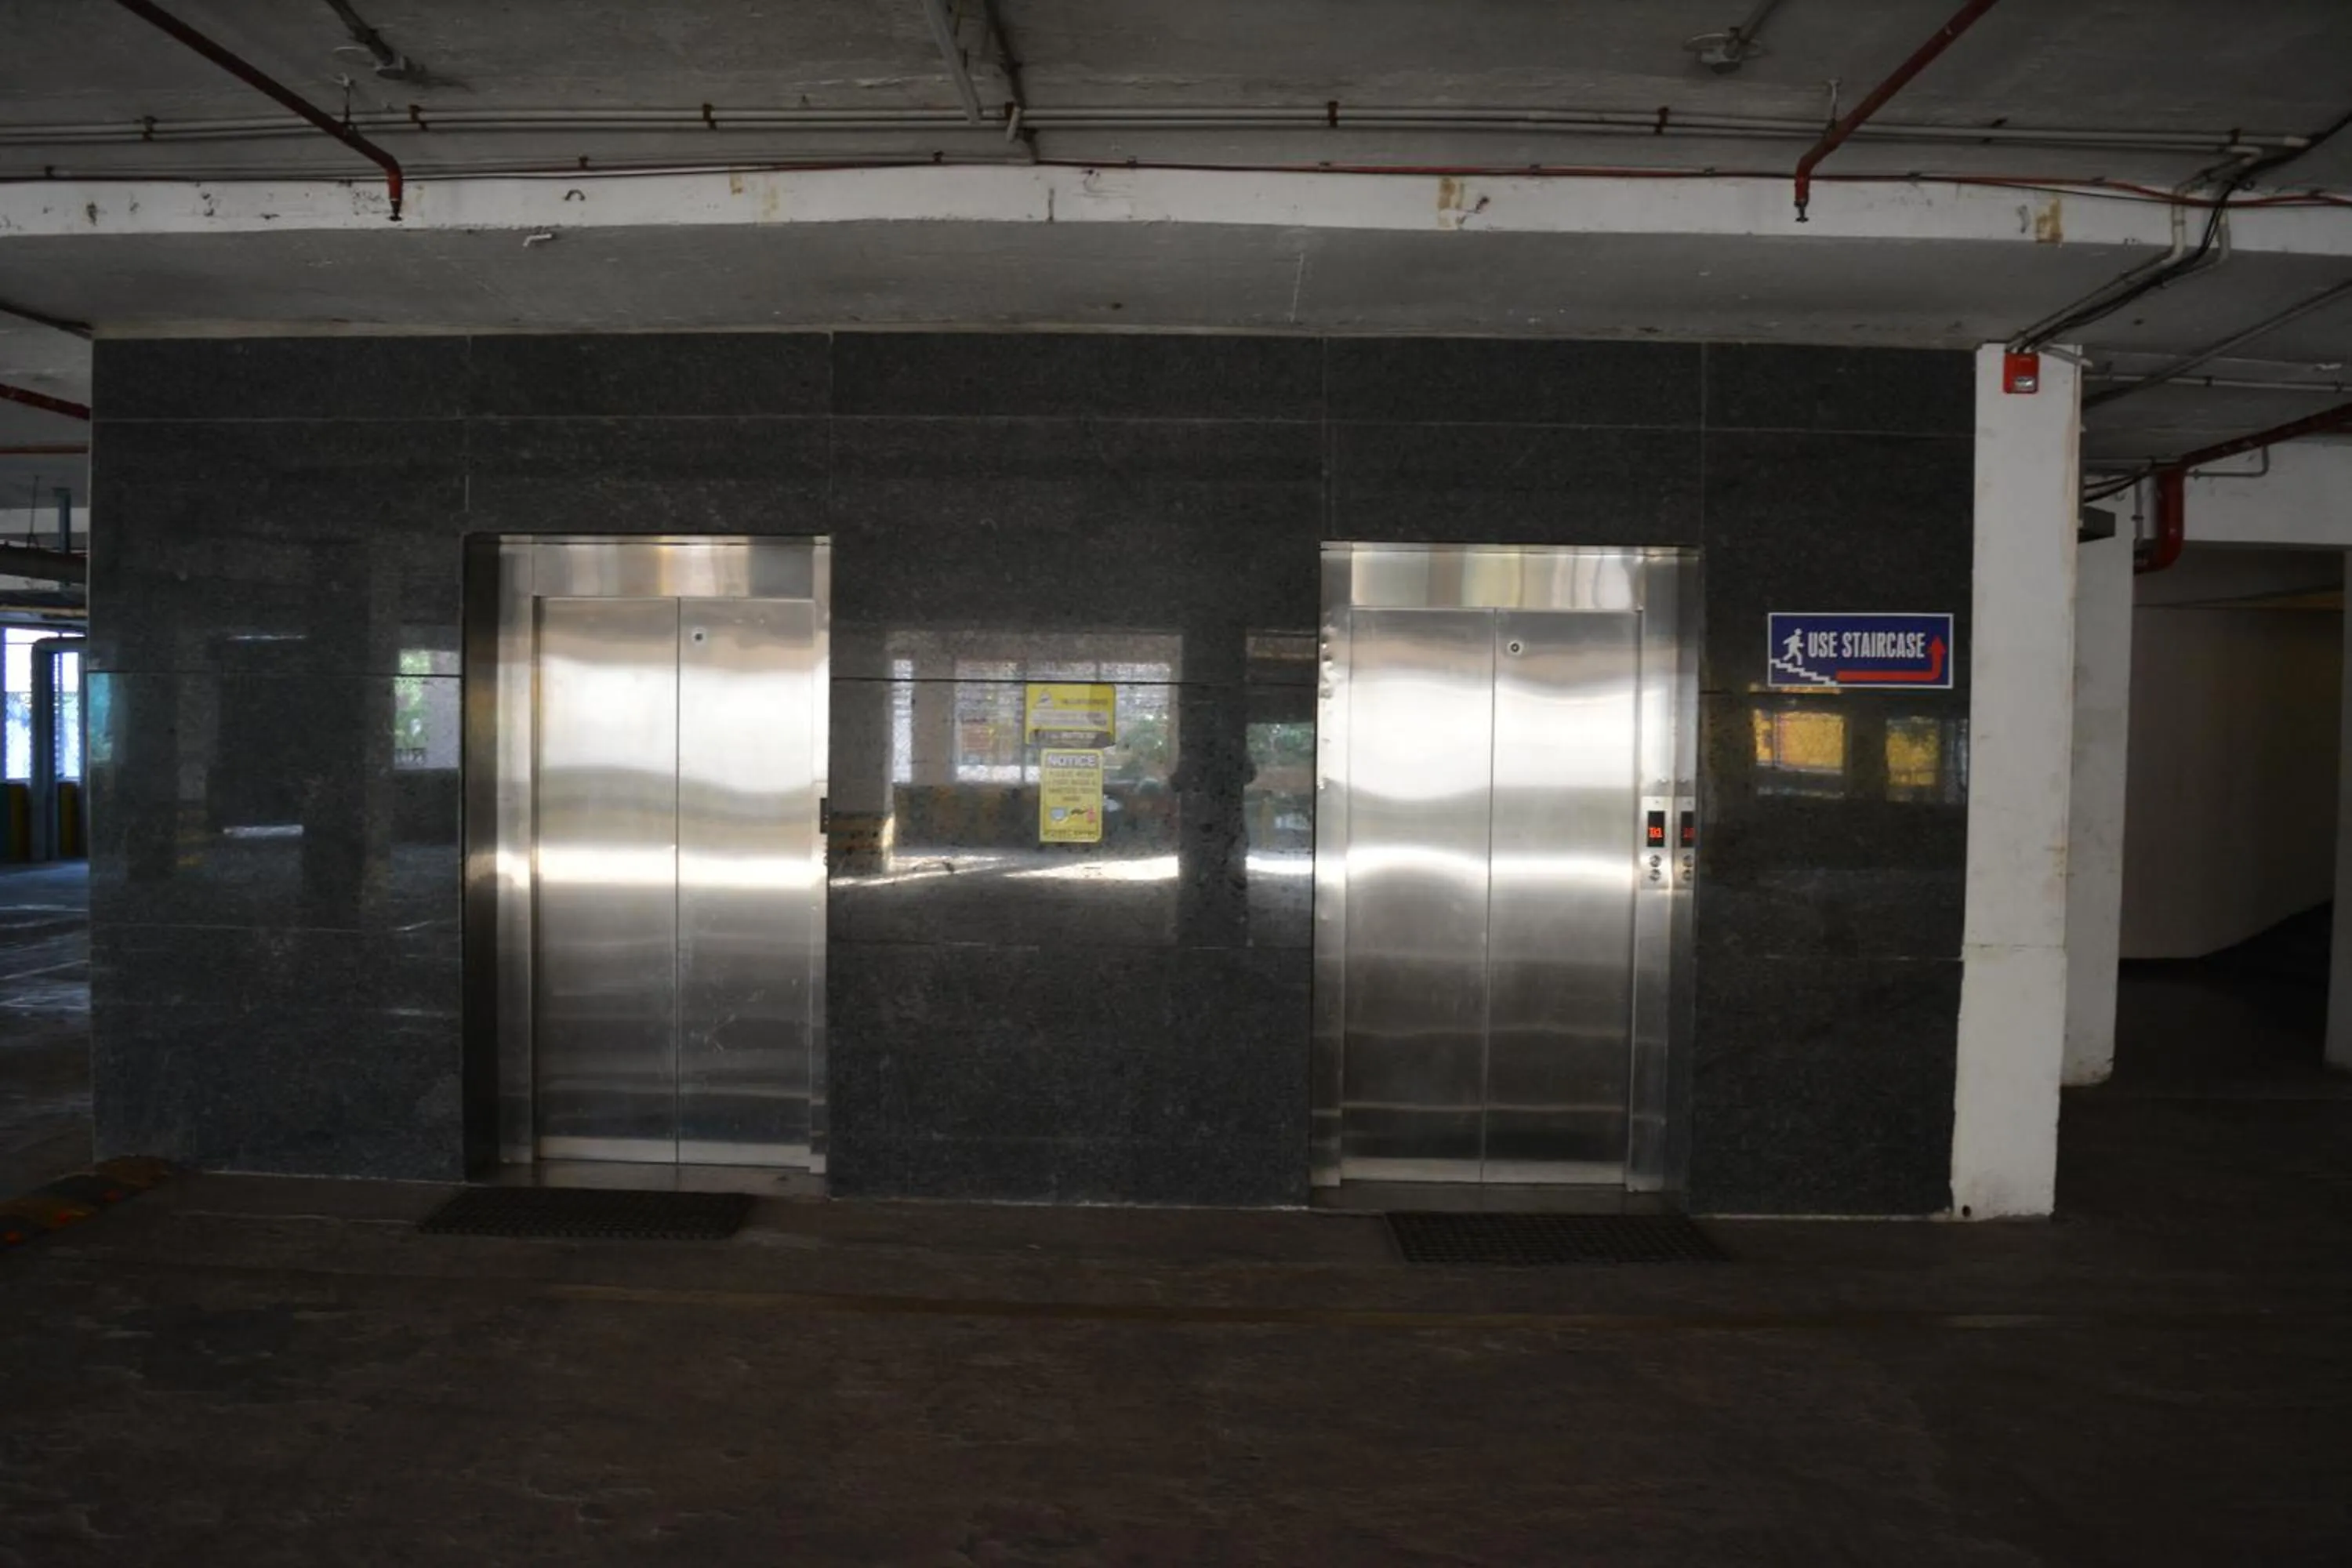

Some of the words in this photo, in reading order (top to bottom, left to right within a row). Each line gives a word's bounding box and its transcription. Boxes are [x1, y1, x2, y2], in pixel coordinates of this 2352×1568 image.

[1807, 631, 1838, 658] USE
[1842, 631, 1926, 659] STAIRCASE
[1048, 754, 1095, 767] NOTICE
